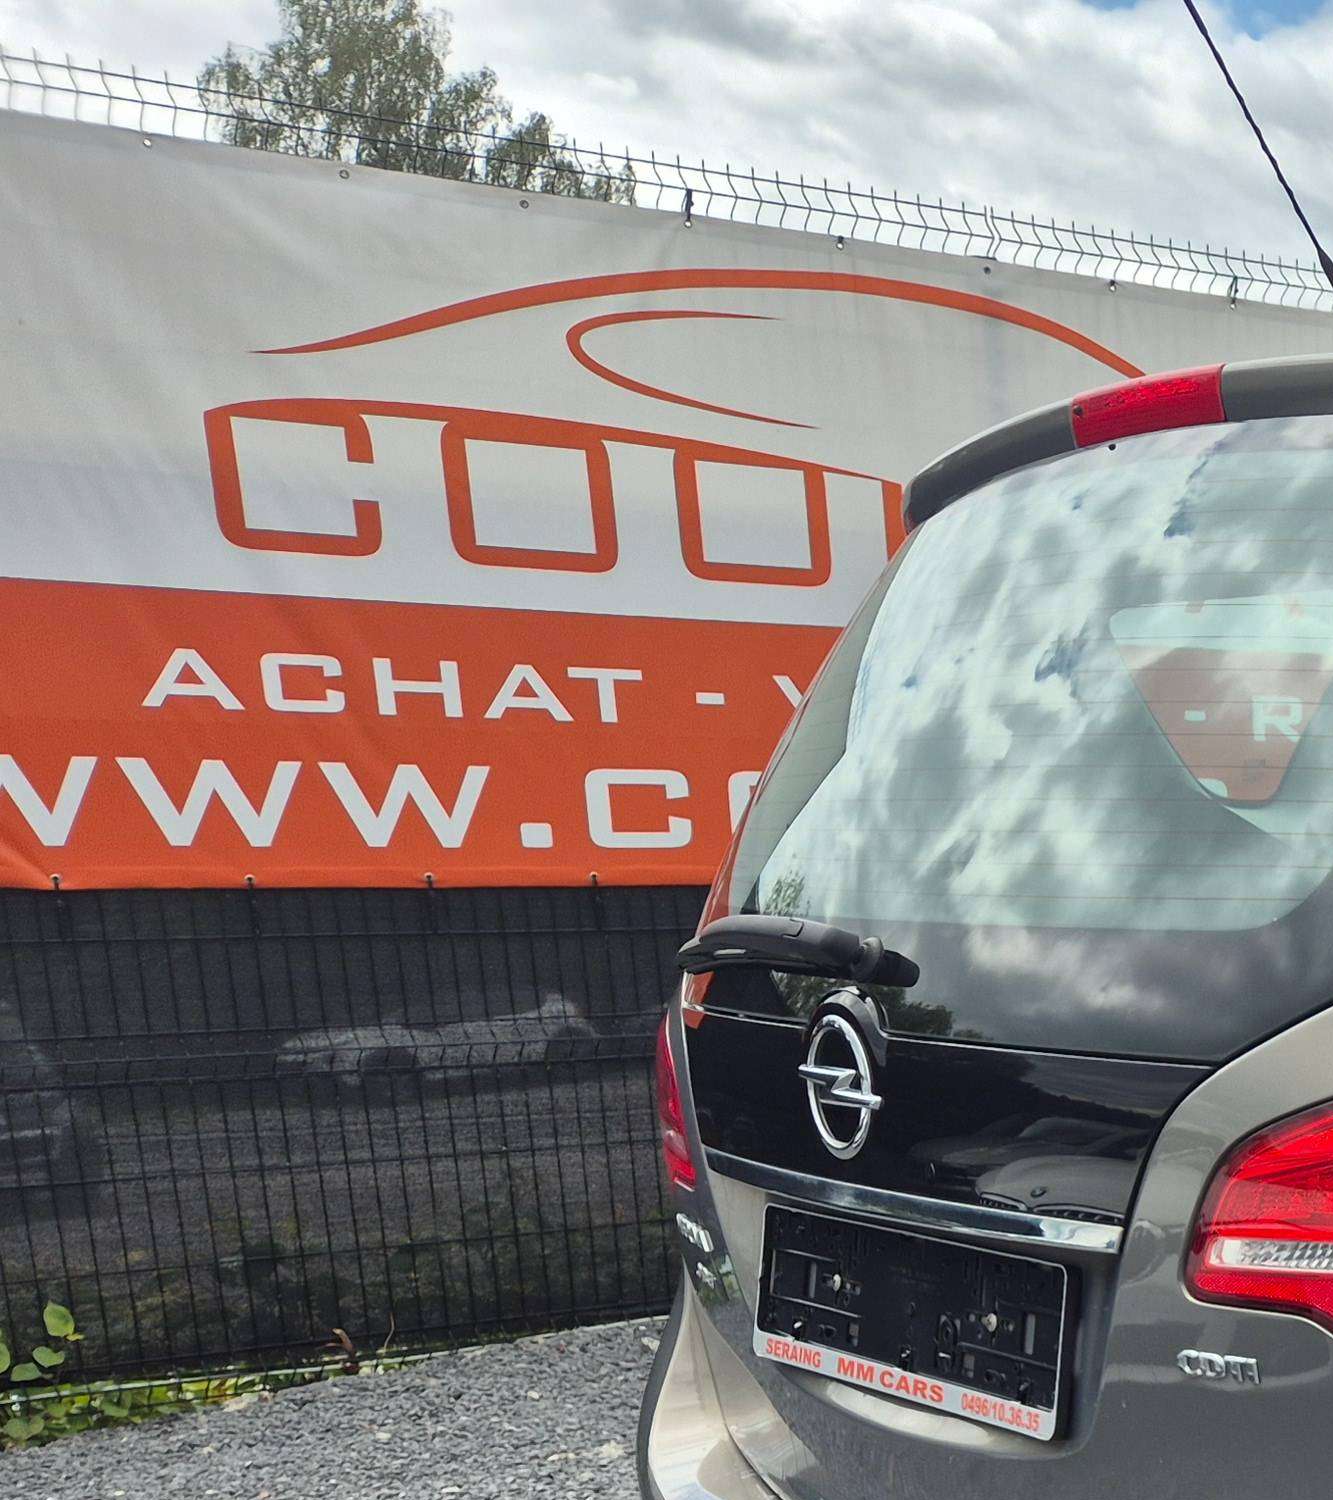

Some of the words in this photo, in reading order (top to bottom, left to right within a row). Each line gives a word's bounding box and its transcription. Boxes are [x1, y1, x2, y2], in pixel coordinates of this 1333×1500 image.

[203, 397, 905, 587] COO
[142, 648, 643, 723] ACHAT
[766, 1337, 822, 1369] SERAING
[837, 1355, 876, 1384] MM
[879, 1369, 945, 1403] CARS
[1176, 1348, 1261, 1385] CDTI
